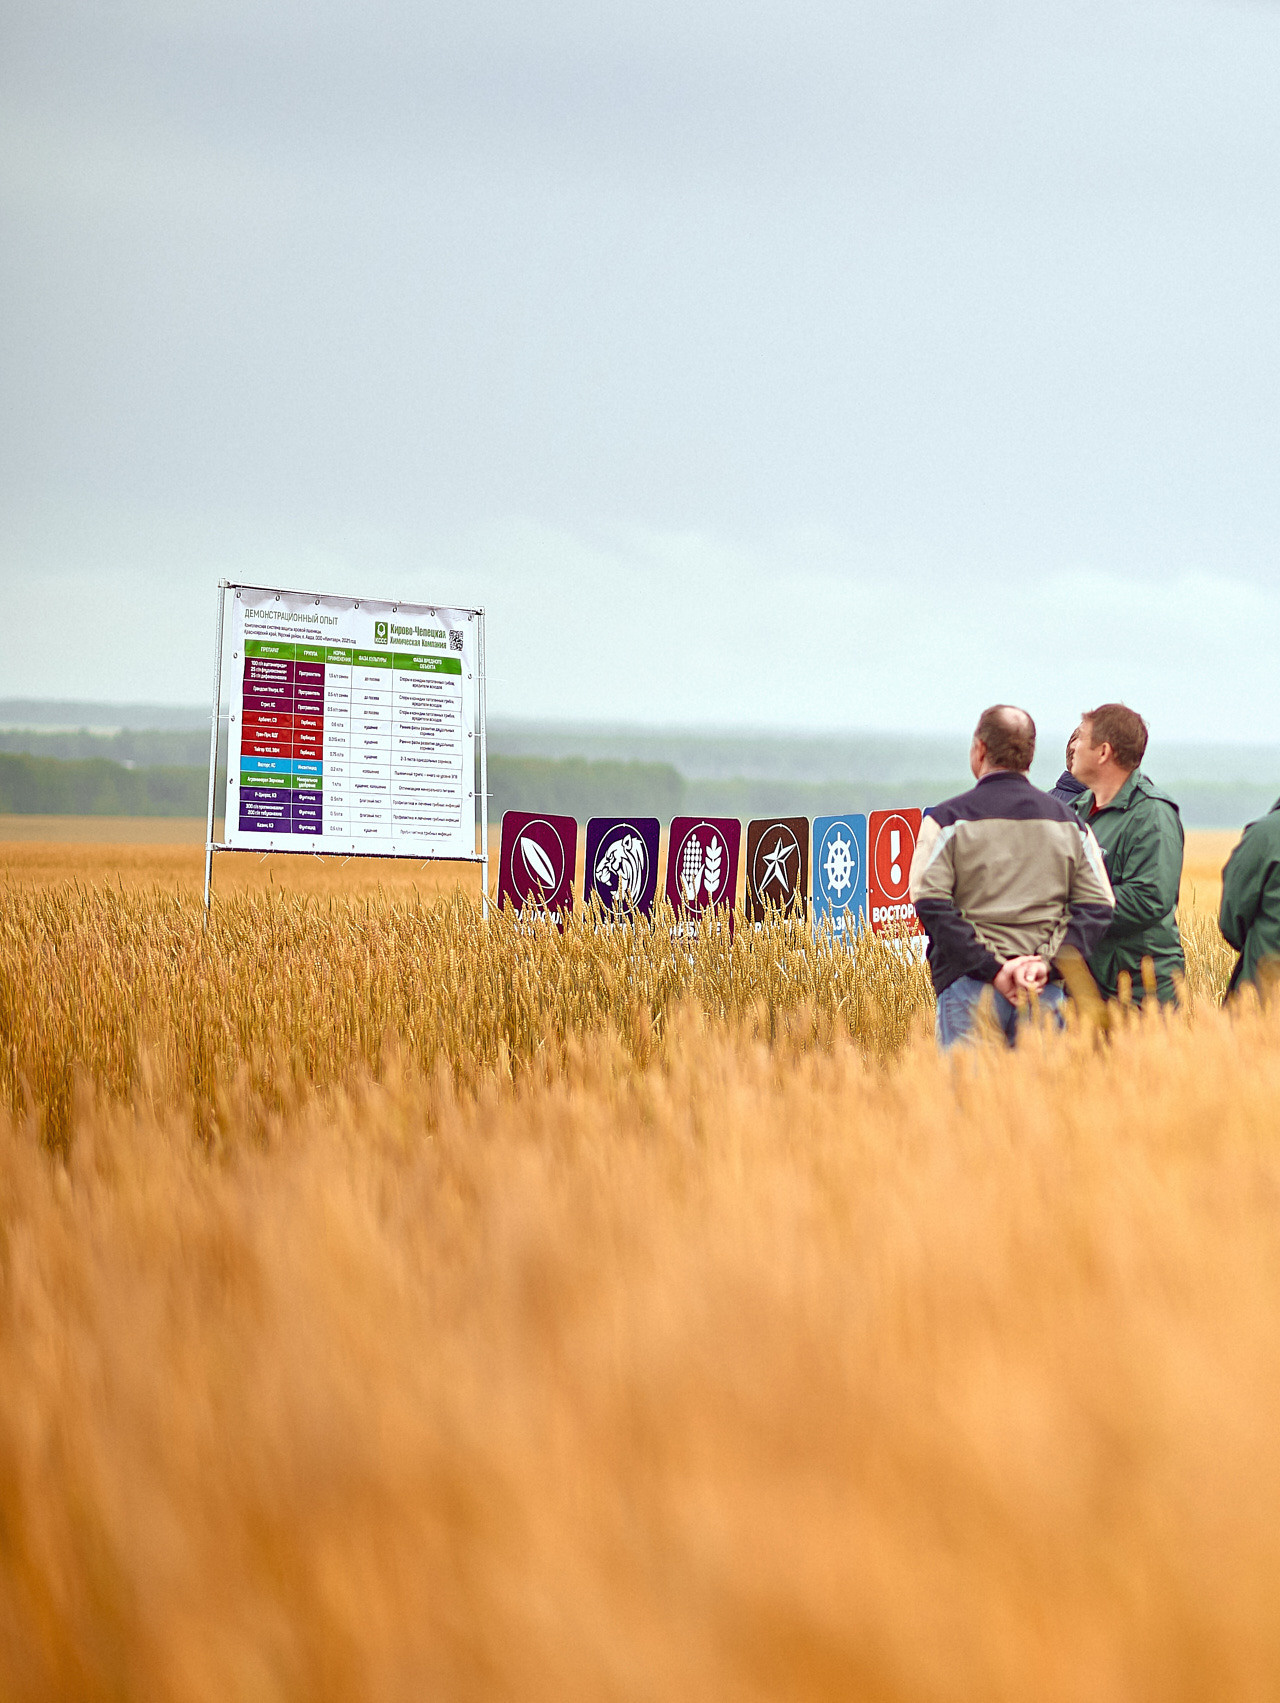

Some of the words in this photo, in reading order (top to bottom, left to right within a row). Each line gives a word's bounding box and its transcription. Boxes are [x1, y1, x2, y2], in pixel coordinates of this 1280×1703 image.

[245, 609, 318, 623] ДЕМОНСТРАЦИОННЫЙ
[320, 616, 338, 625] ОПЫТ
[390, 624, 446, 638] Кирово-Чепецкая
[390, 637, 420, 646] Химическая
[422, 639, 446, 649] Компания
